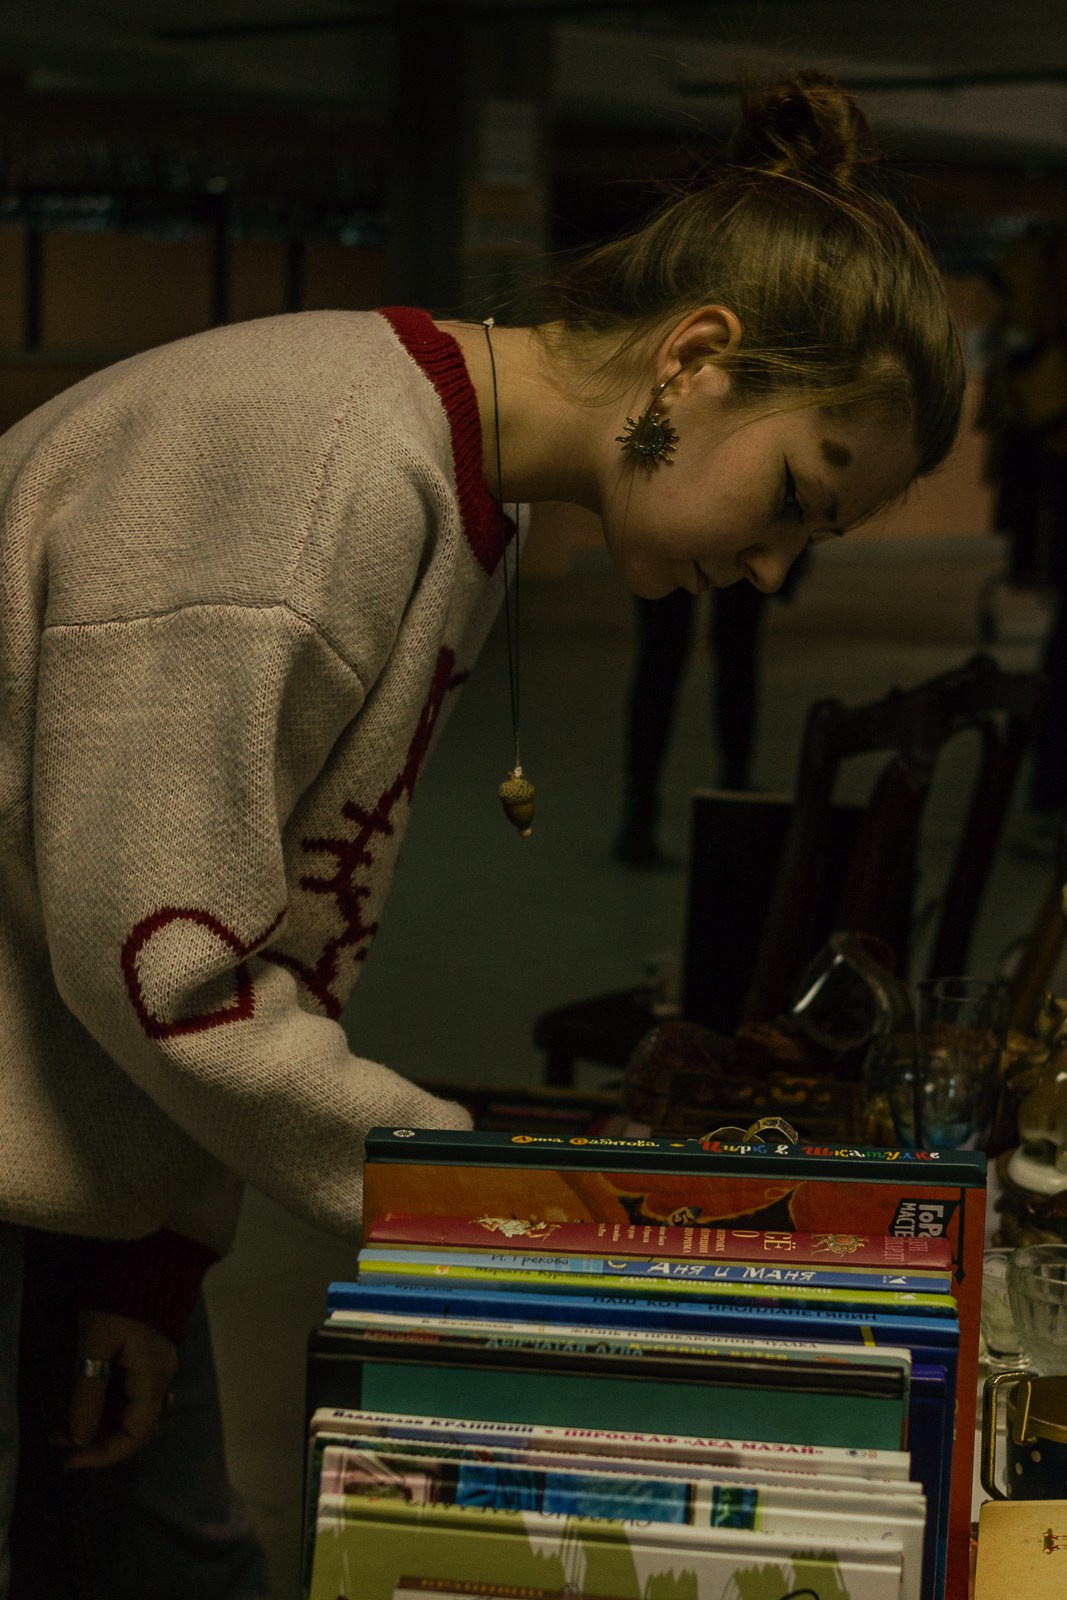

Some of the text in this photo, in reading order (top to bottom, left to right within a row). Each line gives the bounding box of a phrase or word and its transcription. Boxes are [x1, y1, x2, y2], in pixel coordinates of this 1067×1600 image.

[698, 1139, 768, 1153] Цирк
[802, 1146, 940, 1161] Шкатулке
[894, 1202, 917, 1237] МАСТЕ
[763, 1231, 797, 1251] СЁ
